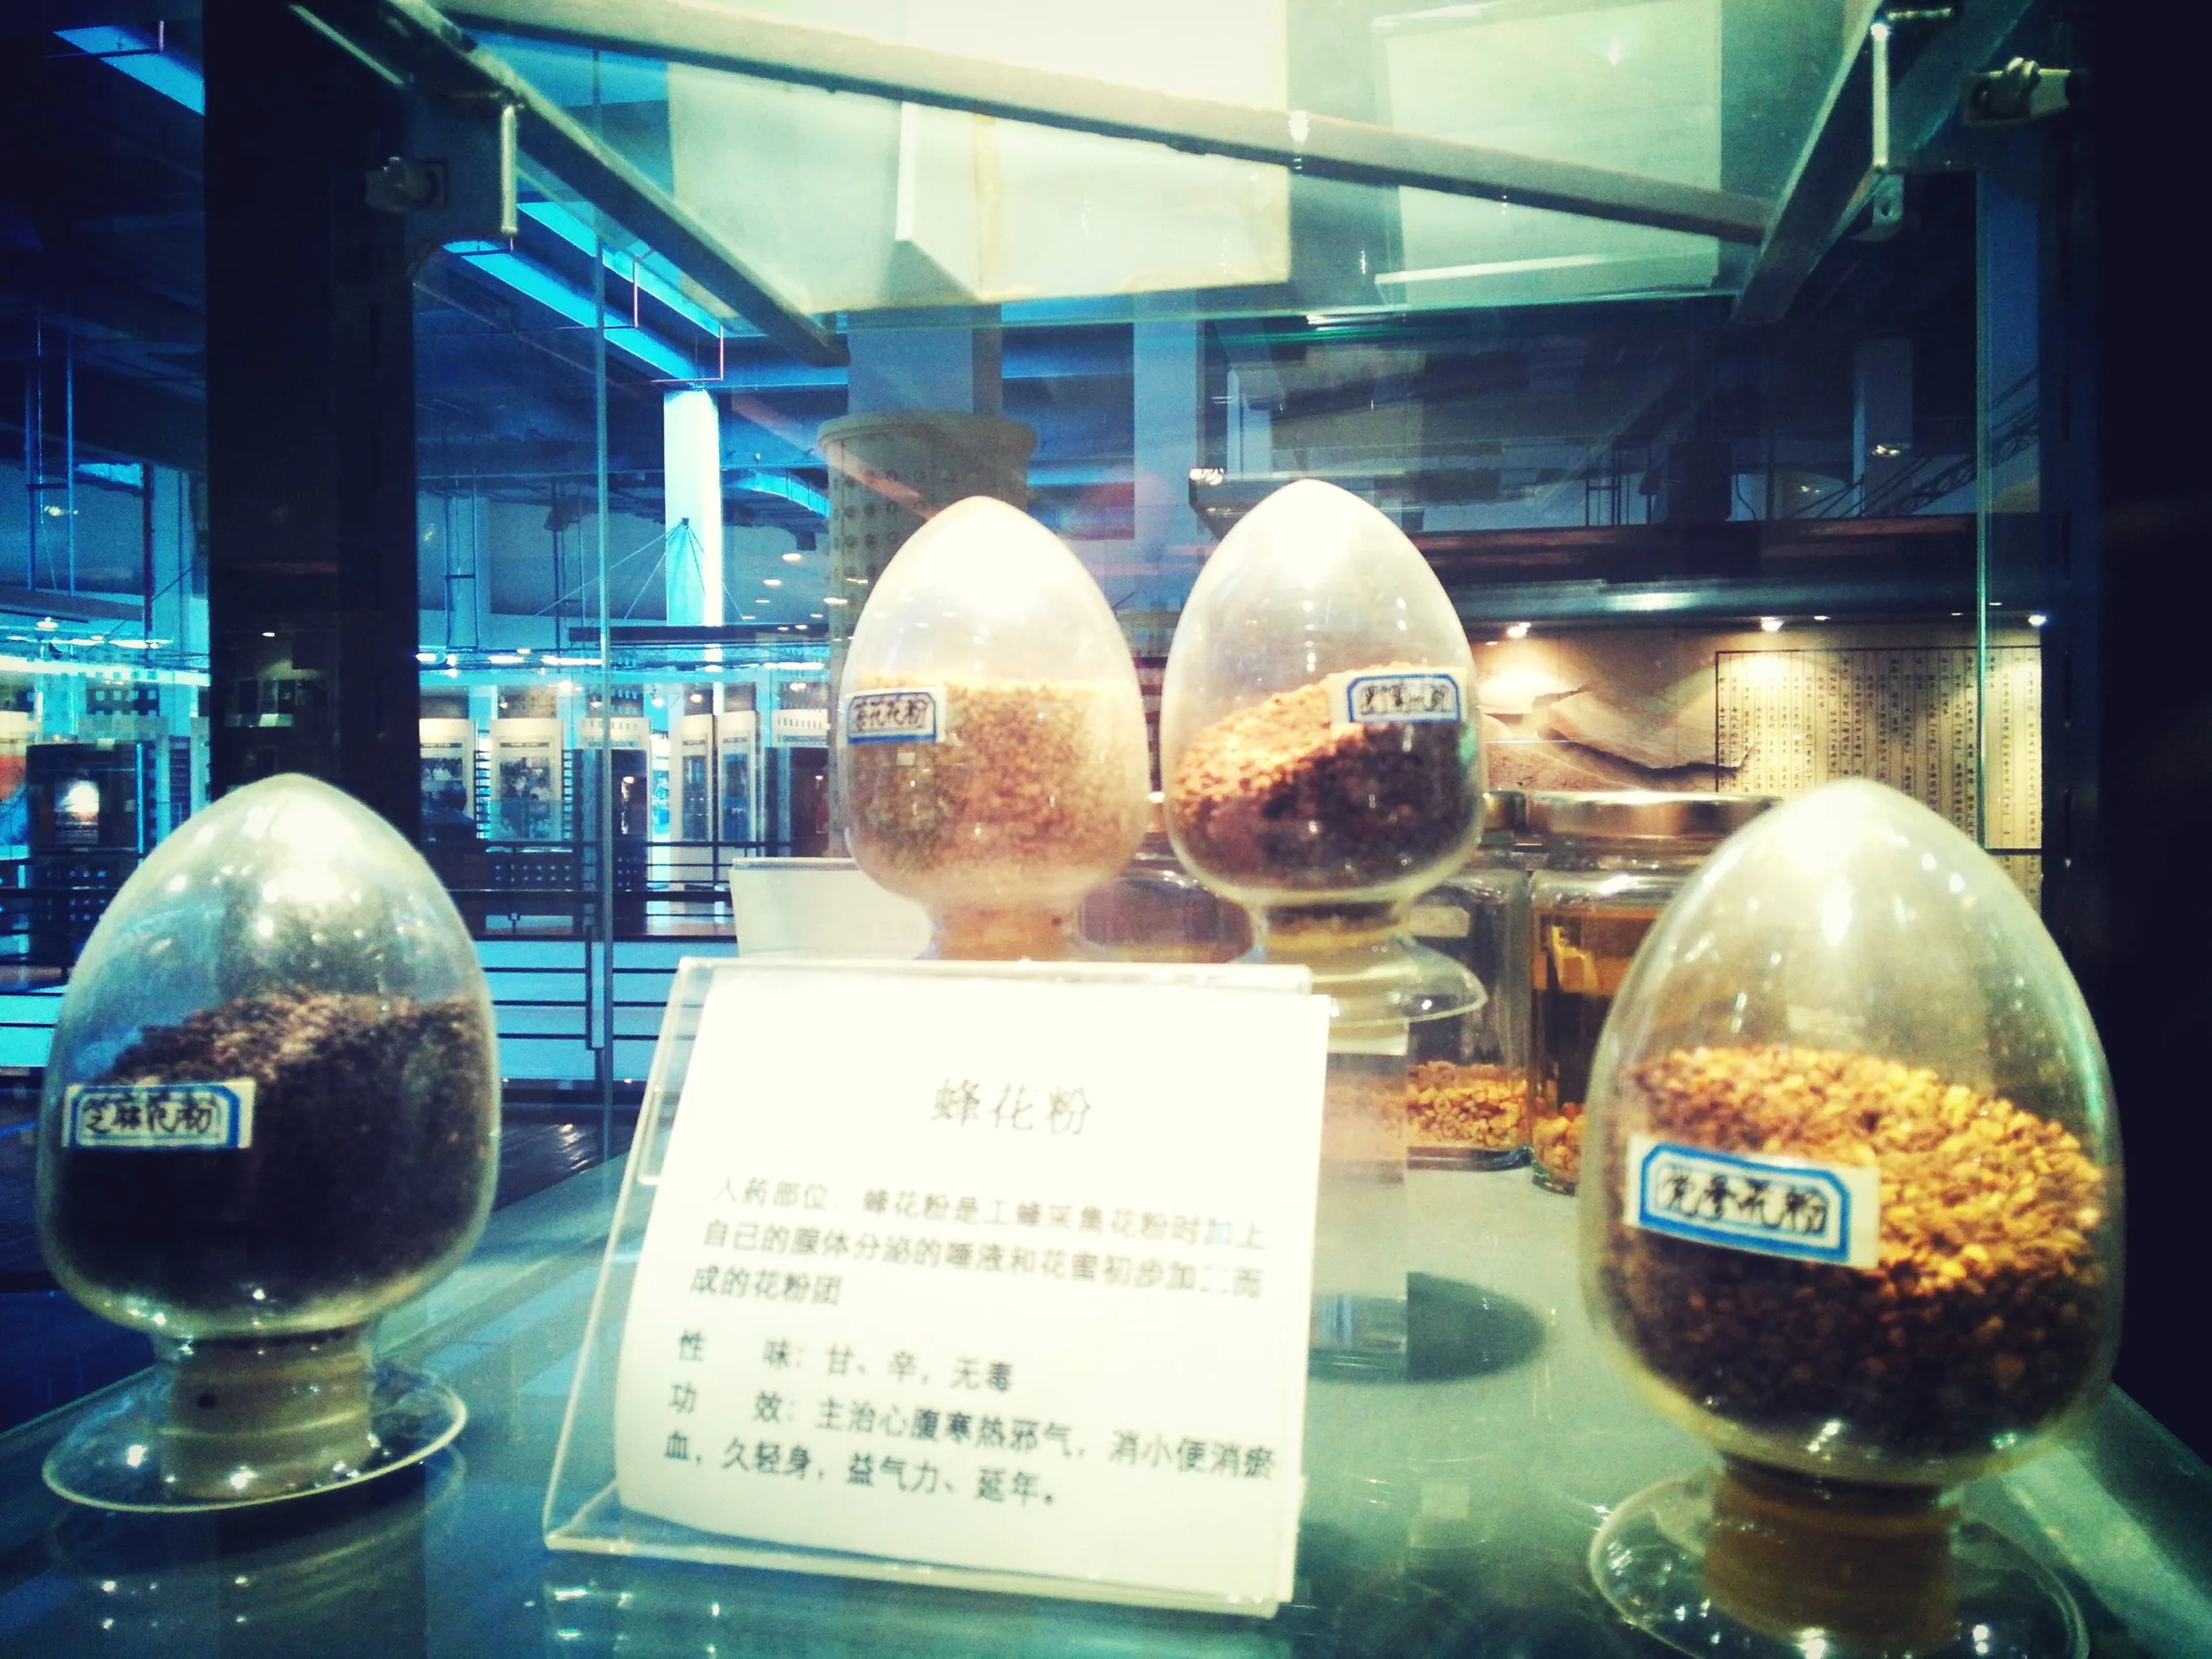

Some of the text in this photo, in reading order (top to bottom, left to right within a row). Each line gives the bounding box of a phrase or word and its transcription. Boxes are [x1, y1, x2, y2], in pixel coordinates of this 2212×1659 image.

[932, 1077, 1092, 1136] 蜂花粉
[690, 1263, 843, 1307] 成的花粉团
